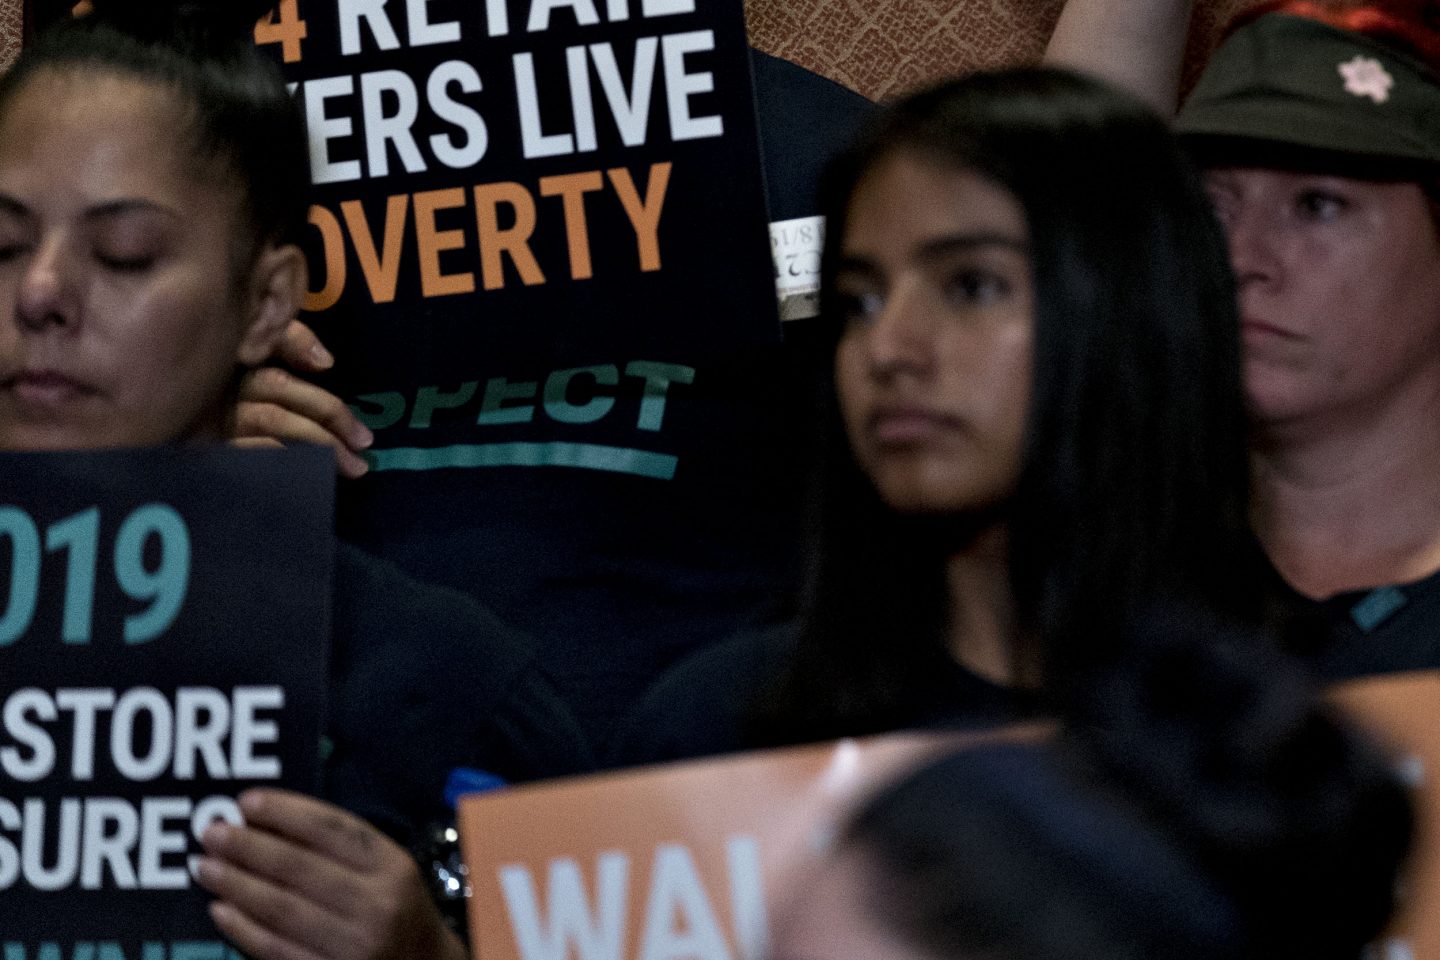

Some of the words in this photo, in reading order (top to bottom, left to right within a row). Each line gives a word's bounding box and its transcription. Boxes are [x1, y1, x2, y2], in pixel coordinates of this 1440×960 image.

[287, 58, 490, 186] ERS
[511, 27, 725, 160] LIVE
[2, 686, 286, 782] STORE
